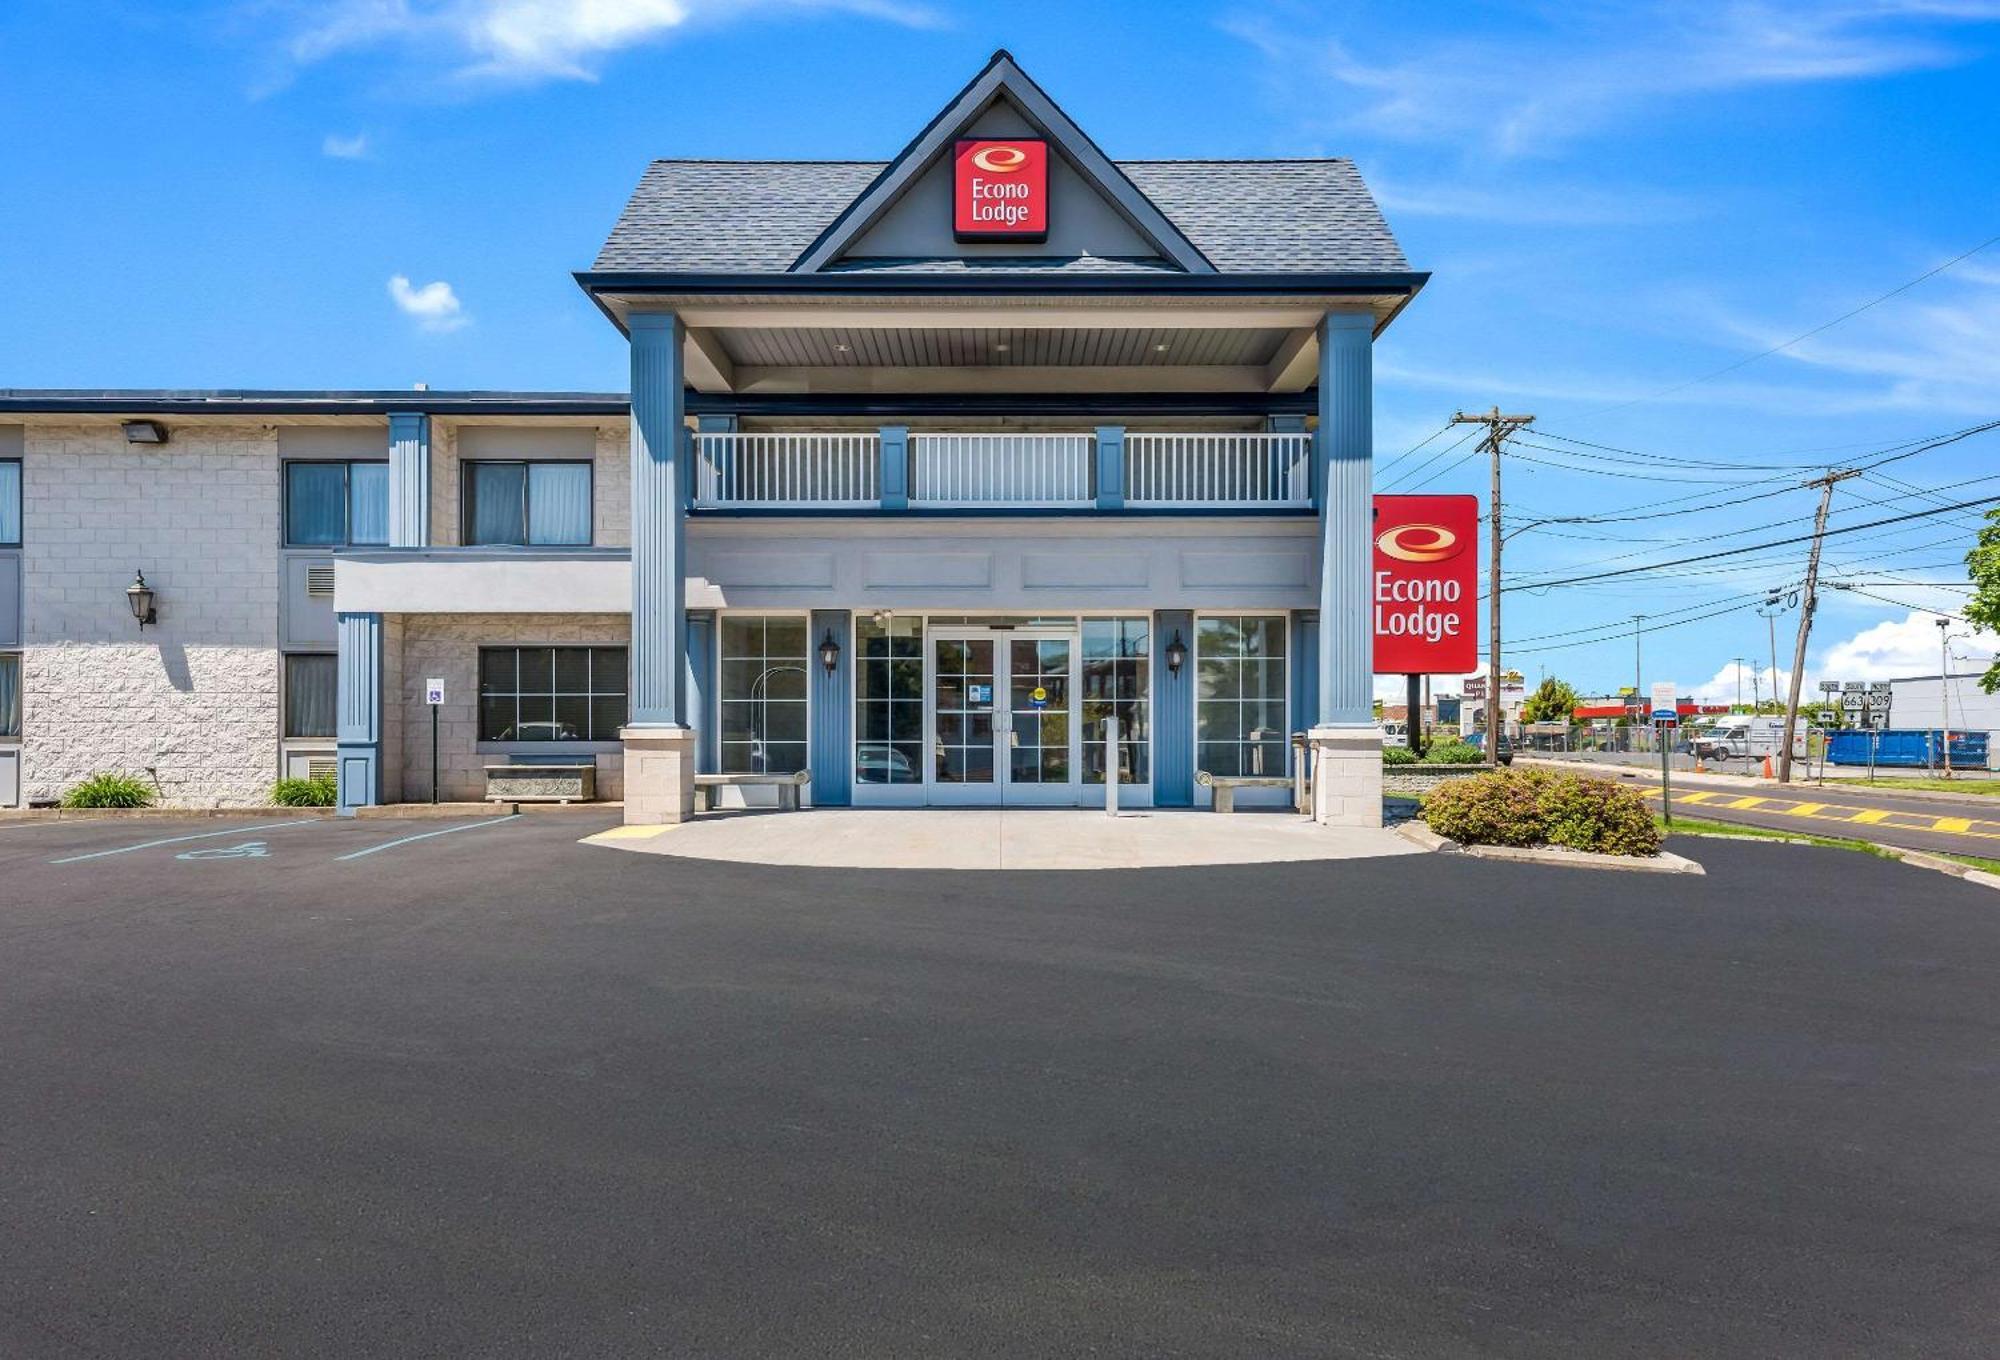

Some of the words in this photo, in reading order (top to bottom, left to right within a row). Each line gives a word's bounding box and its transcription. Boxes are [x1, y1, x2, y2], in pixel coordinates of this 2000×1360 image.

[972, 178, 1029, 199] Econo
[972, 200, 1029, 226] Lodge
[1375, 571, 1461, 603] Econo
[1375, 604, 1460, 642] Lodge
[1844, 696, 1864, 706] 663
[1871, 696, 1890, 706] 309
